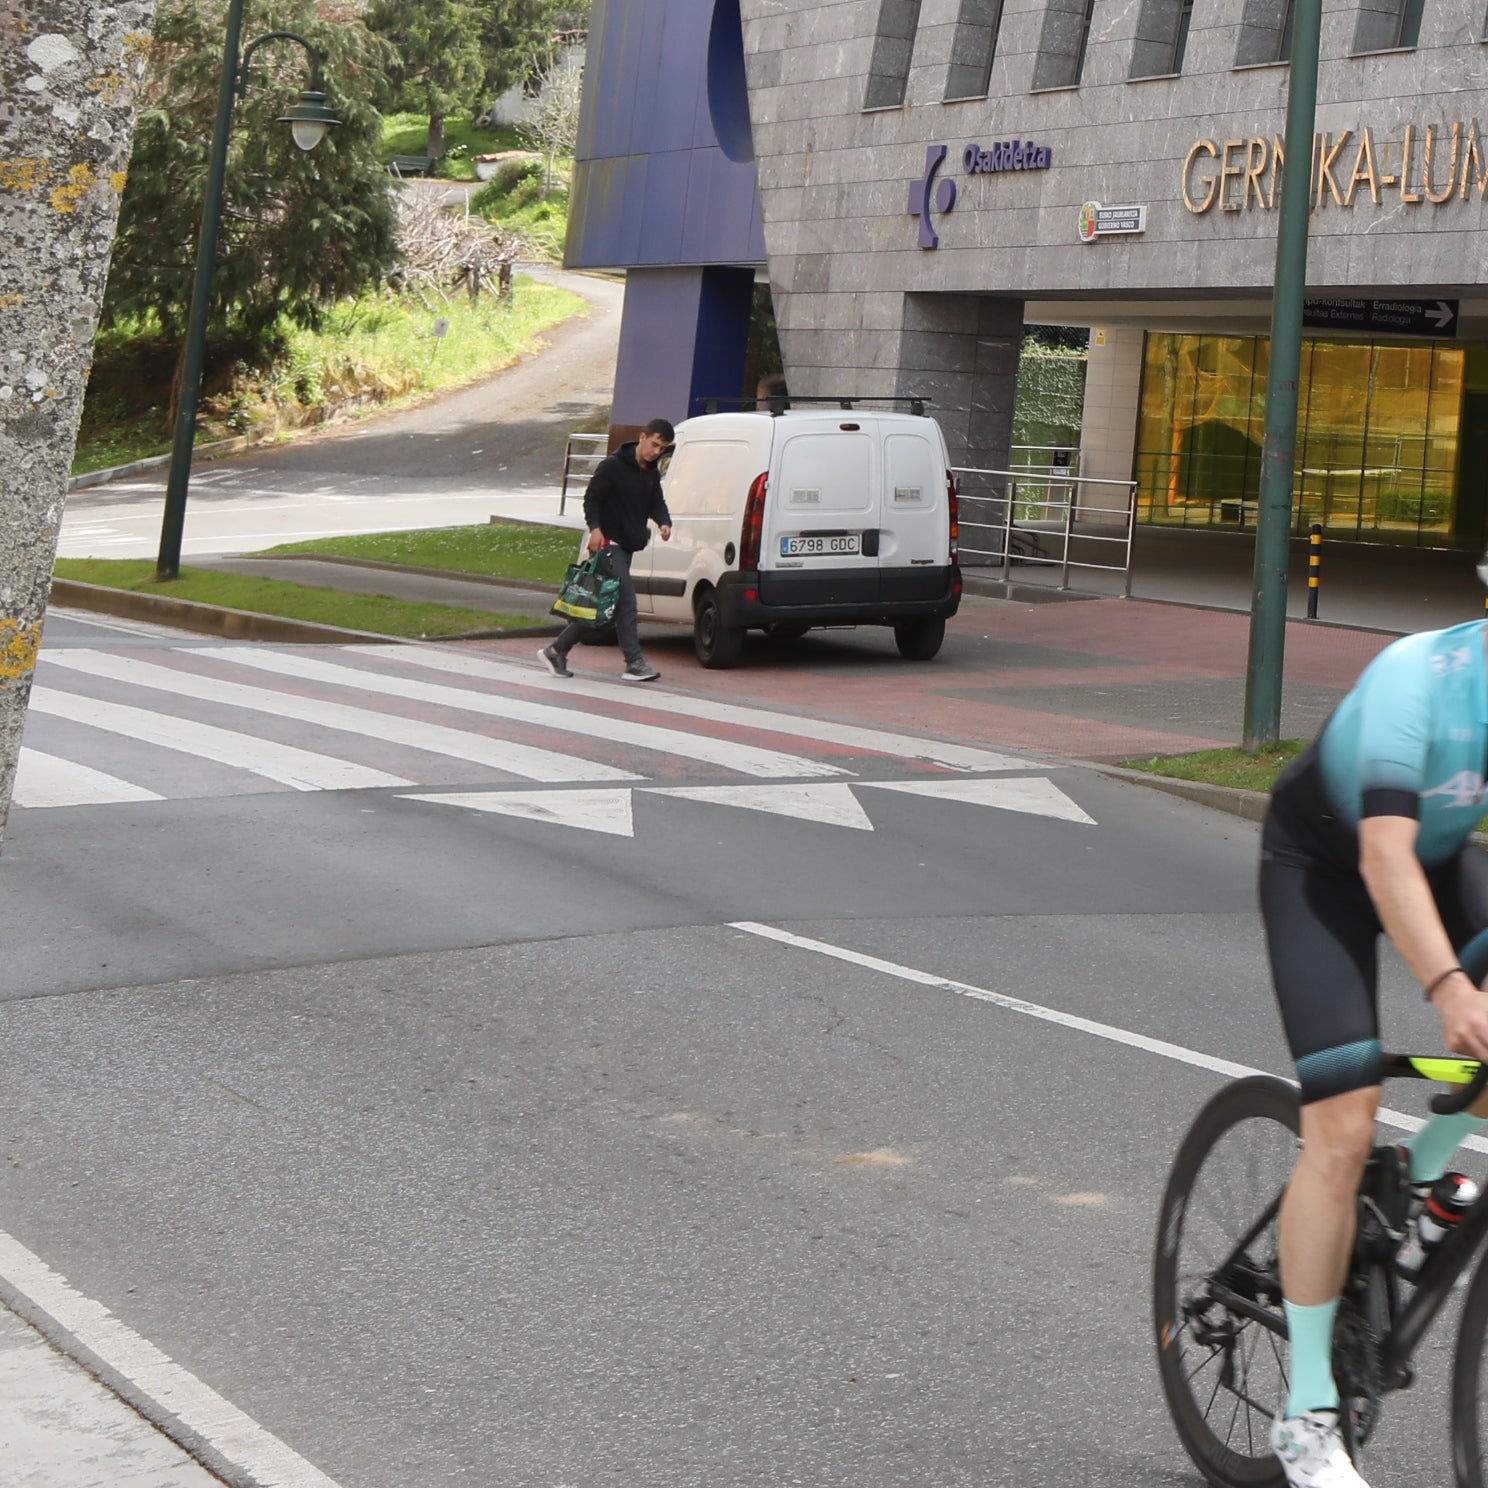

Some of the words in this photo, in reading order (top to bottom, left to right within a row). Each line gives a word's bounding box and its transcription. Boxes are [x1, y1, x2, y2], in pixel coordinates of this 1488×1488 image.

[962, 140, 1052, 174] Osakidetza
[790, 539, 824, 553] 6798
[830, 538, 856, 551] GDC
